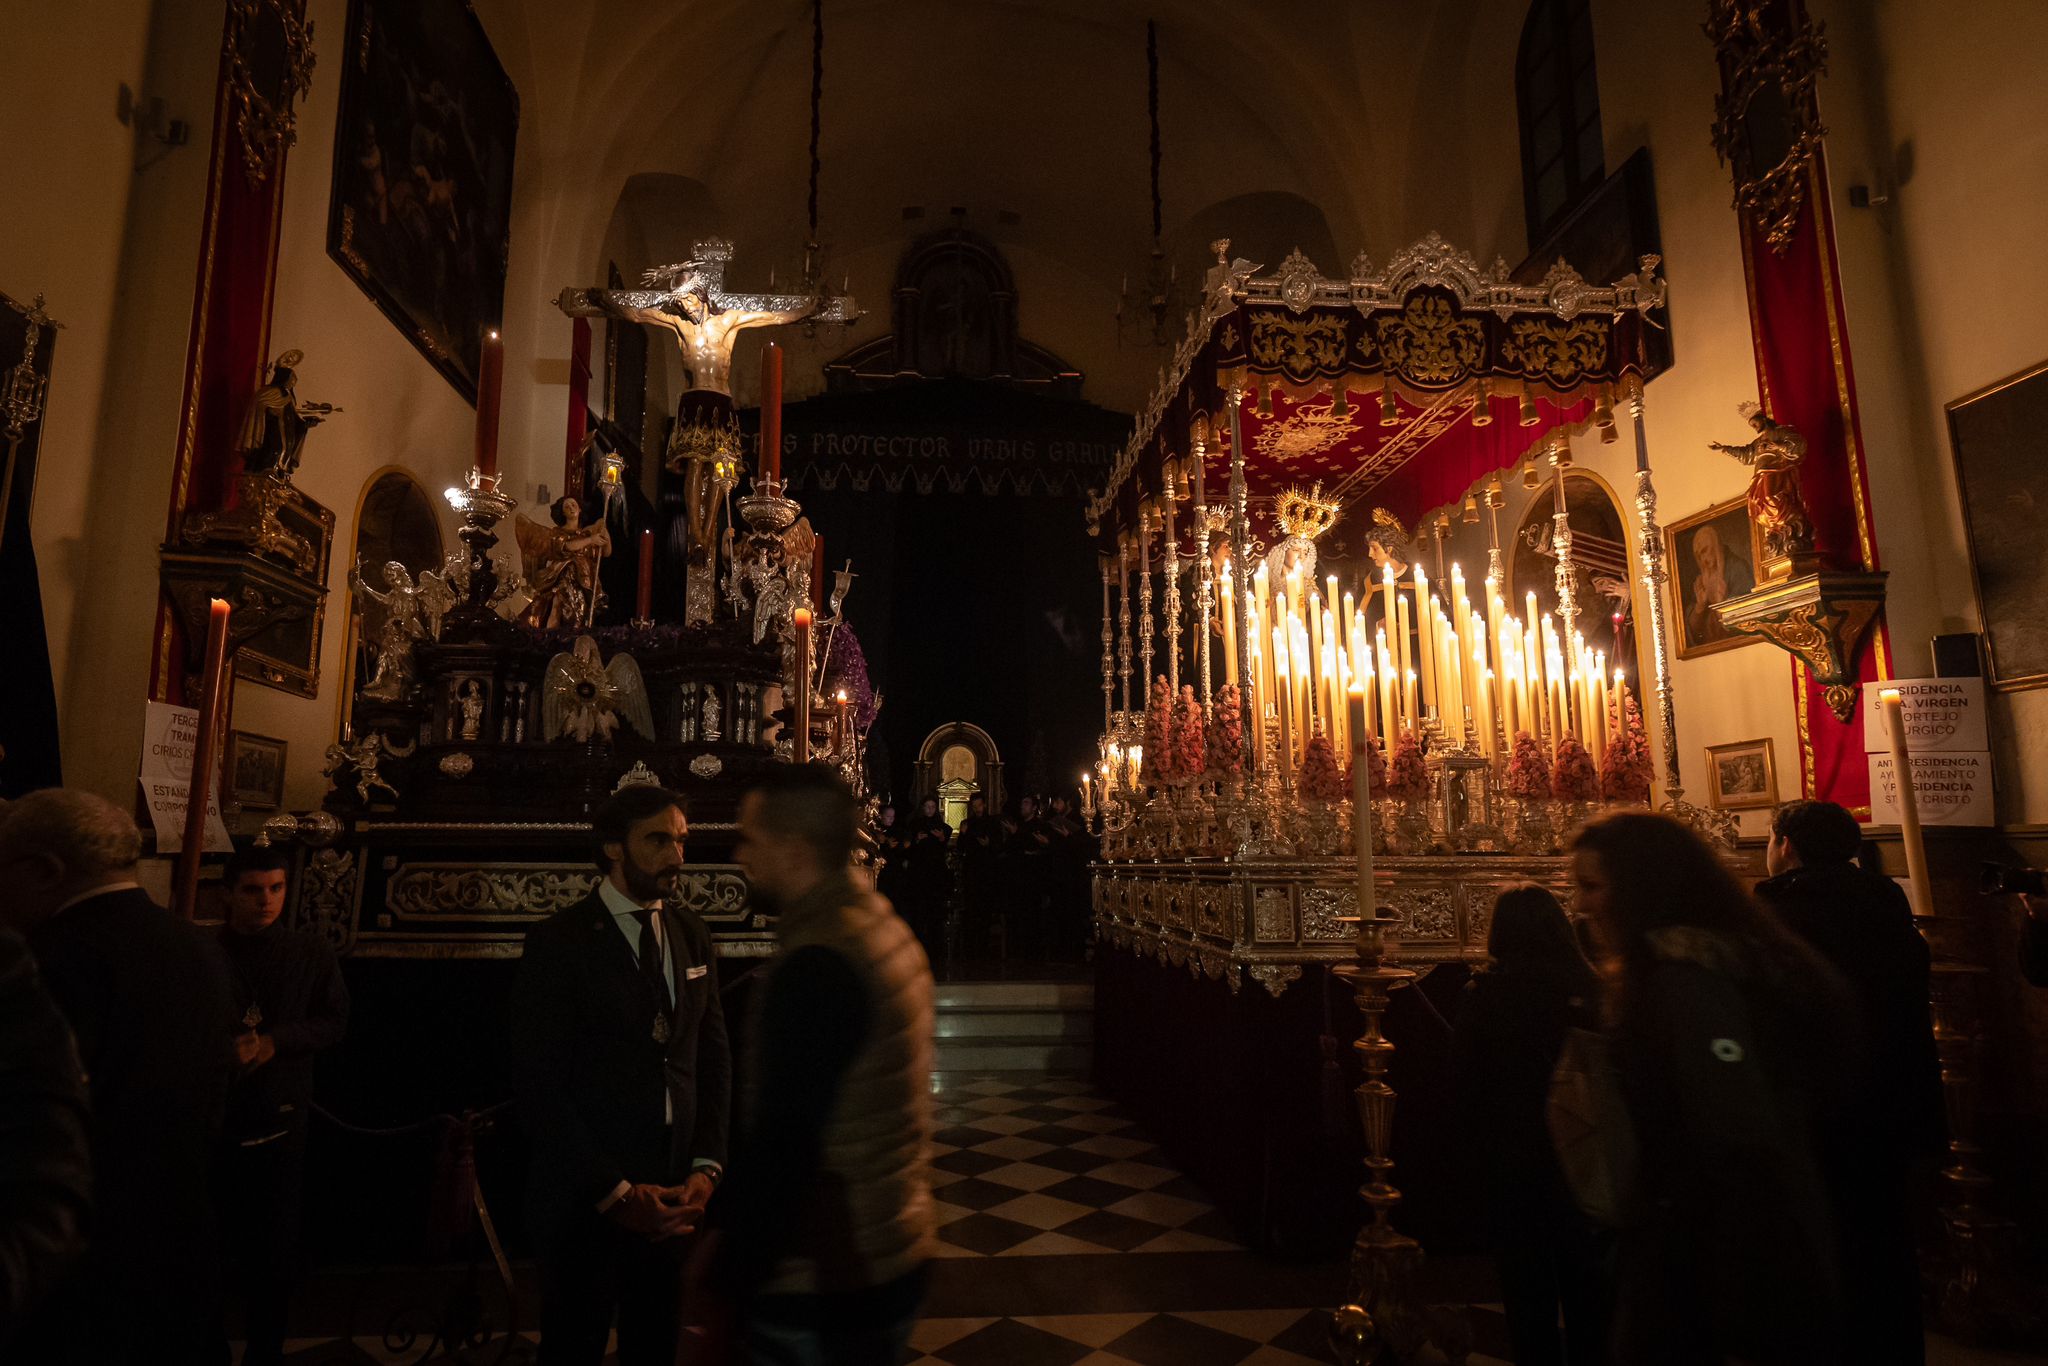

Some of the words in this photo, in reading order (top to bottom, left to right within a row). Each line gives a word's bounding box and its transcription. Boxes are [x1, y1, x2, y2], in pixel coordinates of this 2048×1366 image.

[813, 432, 953, 459] PROTECTOR
[1874, 699, 1912, 711] SA.
[1915, 698, 1968, 708] VIRGEN
[172, 713, 198, 729] TERCE
[1902, 711, 1959, 722] ORTEJO
[171, 730, 195, 744] TRAM
[152, 744, 183, 759] CIRIOS
[1890, 782, 1974, 792] PSIDENCIA
[1922, 794, 1972, 805] CRISTO
